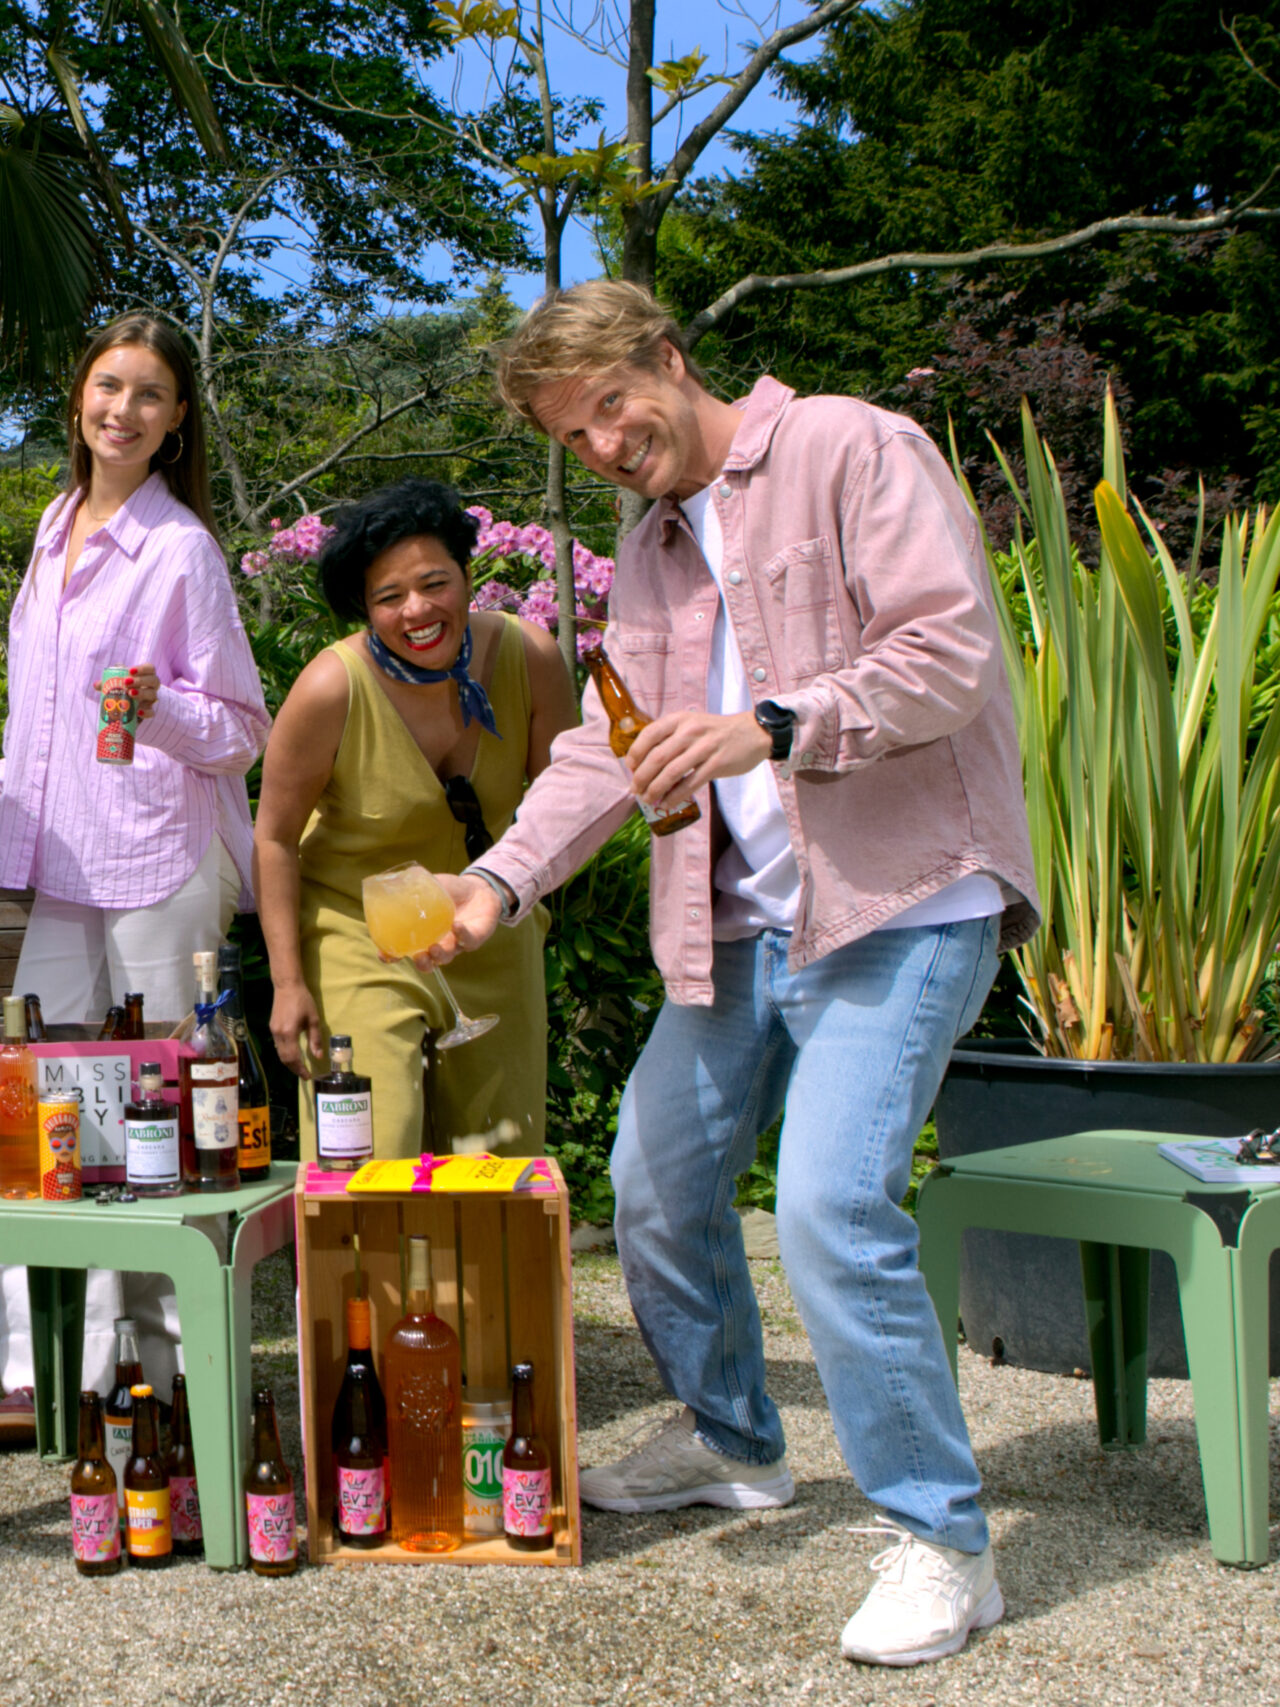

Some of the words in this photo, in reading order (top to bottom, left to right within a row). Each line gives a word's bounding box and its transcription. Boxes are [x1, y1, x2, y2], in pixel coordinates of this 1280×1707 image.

[45, 1062, 126, 1082] MISS
[342, 1490, 372, 1508] EVI
[515, 1493, 546, 1509] EVI
[75, 1517, 105, 1535] EVI
[264, 1518, 292, 1534] EVI
